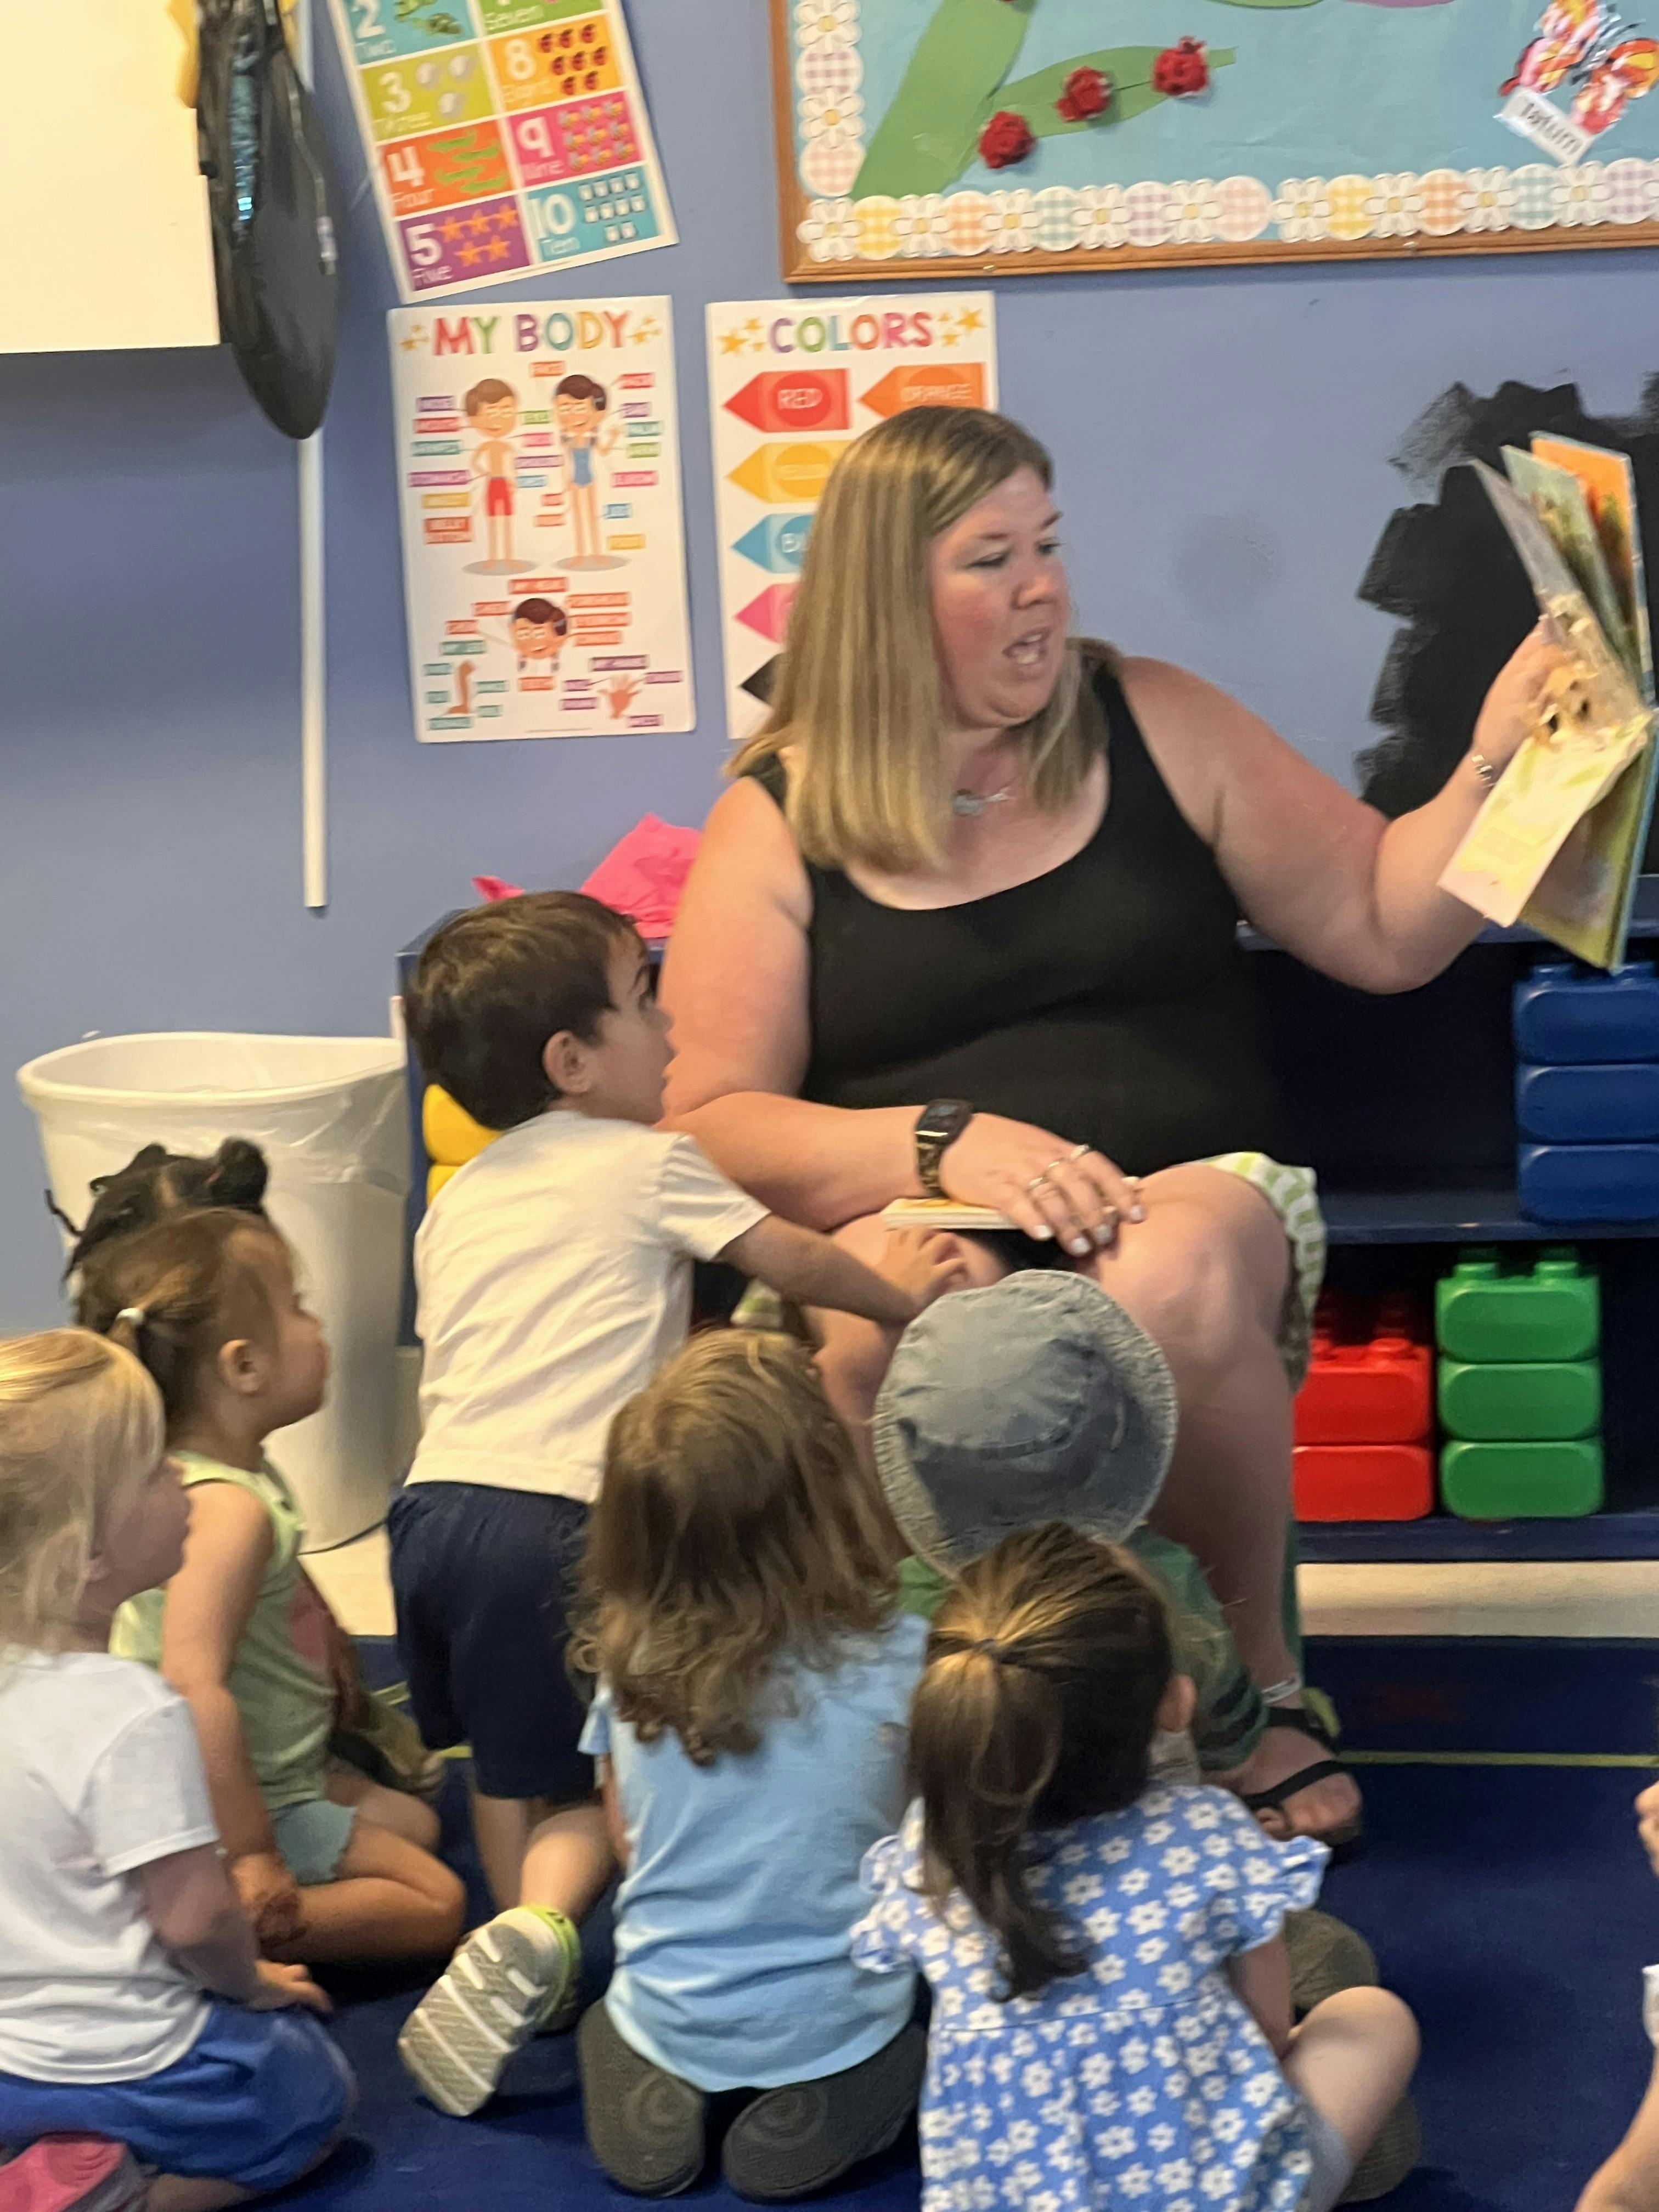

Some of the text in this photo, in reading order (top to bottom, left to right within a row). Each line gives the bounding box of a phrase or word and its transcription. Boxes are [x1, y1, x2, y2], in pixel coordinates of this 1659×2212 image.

[351, 0, 386, 38] 2
[505, 38, 537, 81] 8
[379, 71, 411, 113] 3
[516, 116, 555, 157] 9
[386, 145, 425, 187] 4
[528, 193, 575, 238] 10
[405, 223, 442, 266] 5
[432, 310, 631, 356] MY BODY
[769, 311, 933, 354] COLORS
[777, 387, 823, 410] RED
